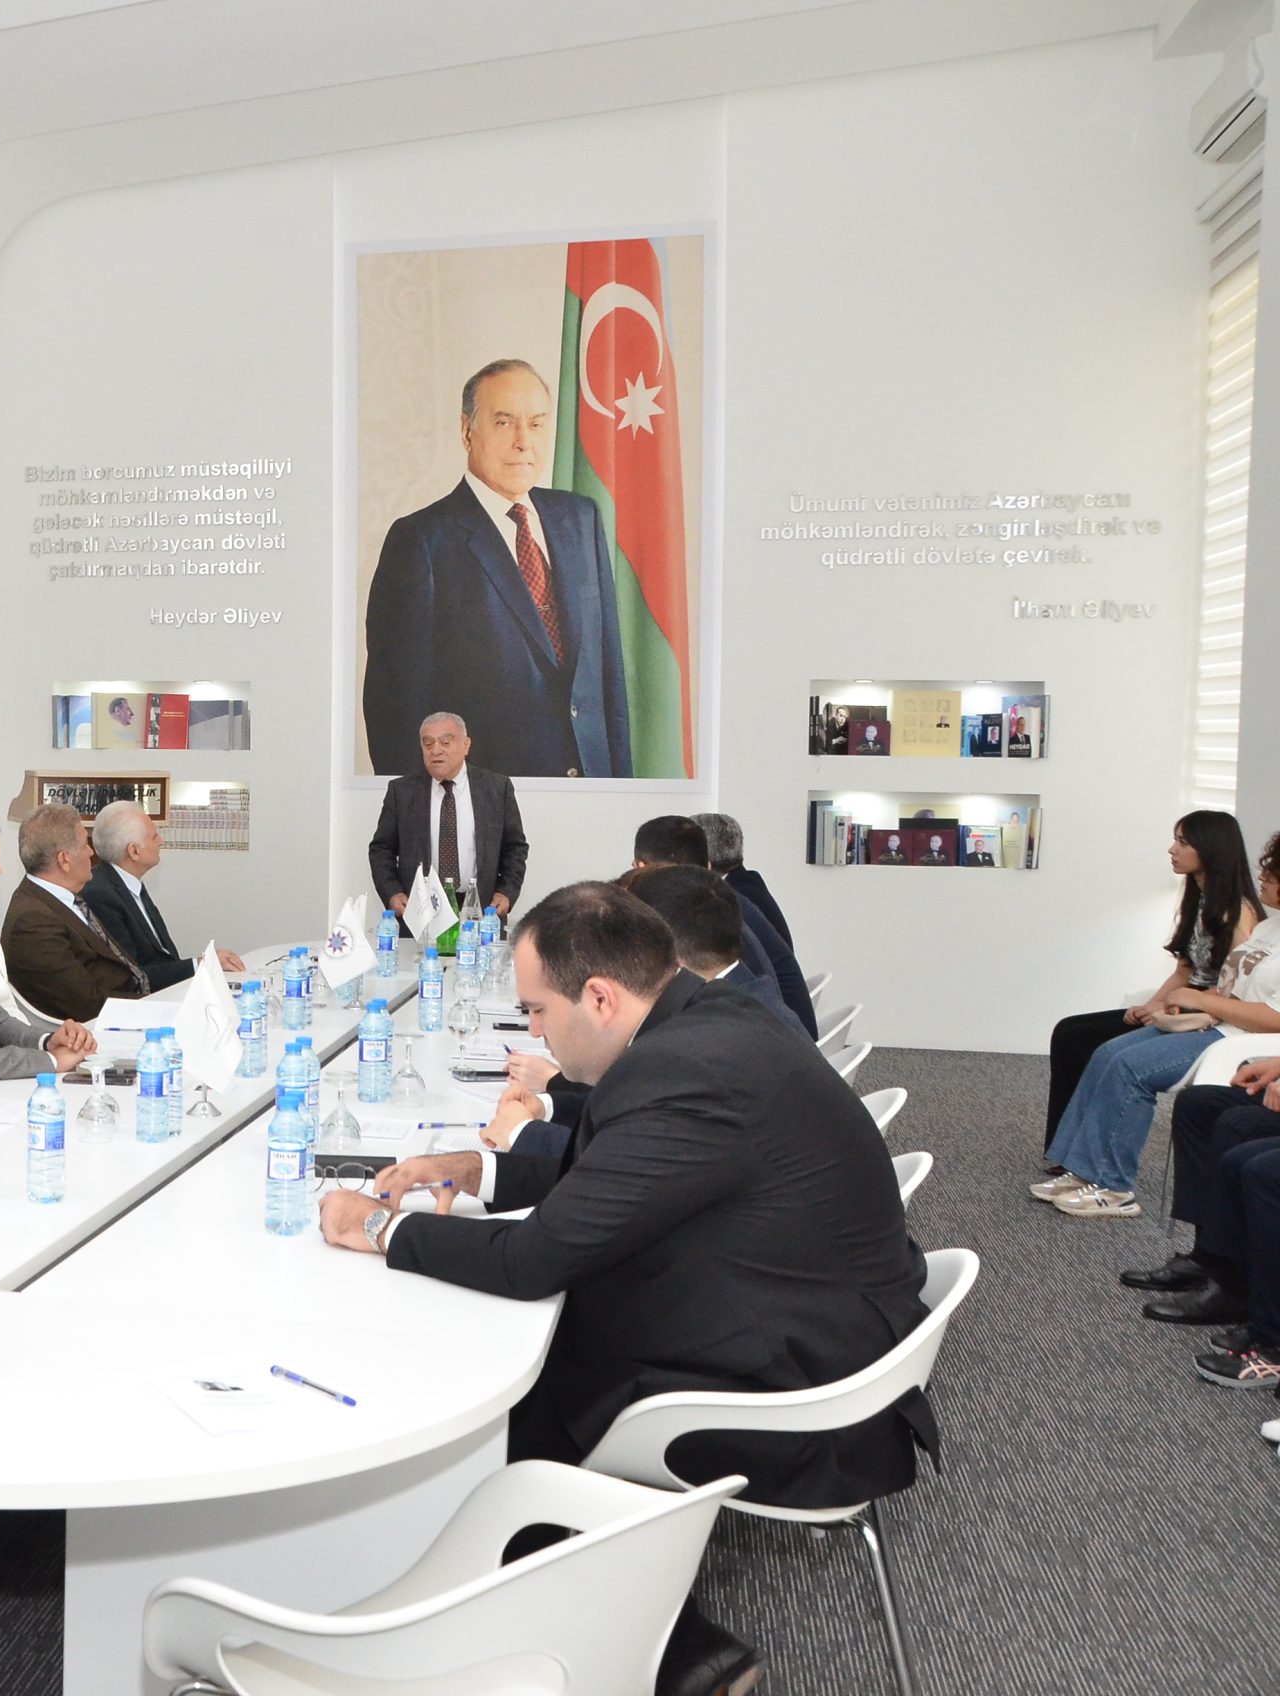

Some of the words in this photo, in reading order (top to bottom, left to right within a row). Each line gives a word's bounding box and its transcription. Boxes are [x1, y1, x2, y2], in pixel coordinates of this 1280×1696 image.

[24, 465, 76, 483] Bizim
[81, 462, 176, 481] borcumuz
[181, 457, 293, 479] müstəqilliyi
[39, 484, 247, 507] möhkəmləndirməkdən
[254, 487, 276, 500] və
[789, 491, 867, 513] Ümumi
[874, 492, 981, 513] vətənimiz
[32, 511, 104, 534] gələcək
[110, 509, 189, 528] nəsillərə
[194, 508, 283, 529] müstəqil,
[760, 519, 951, 542] möhkəmləndirək,
[1133, 519, 1162, 535] və
[29, 536, 100, 557] qüdrətli
[104, 534, 215, 556] Azərbaycan
[221, 531, 286, 551] dövləti
[181, 559, 266, 578] ibarətdir.
[821, 547, 905, 570] qüdrətli
[912, 546, 996, 565] dövlətə
[149, 607, 218, 629] Heydər
[223, 606, 284, 628] Əliyev
